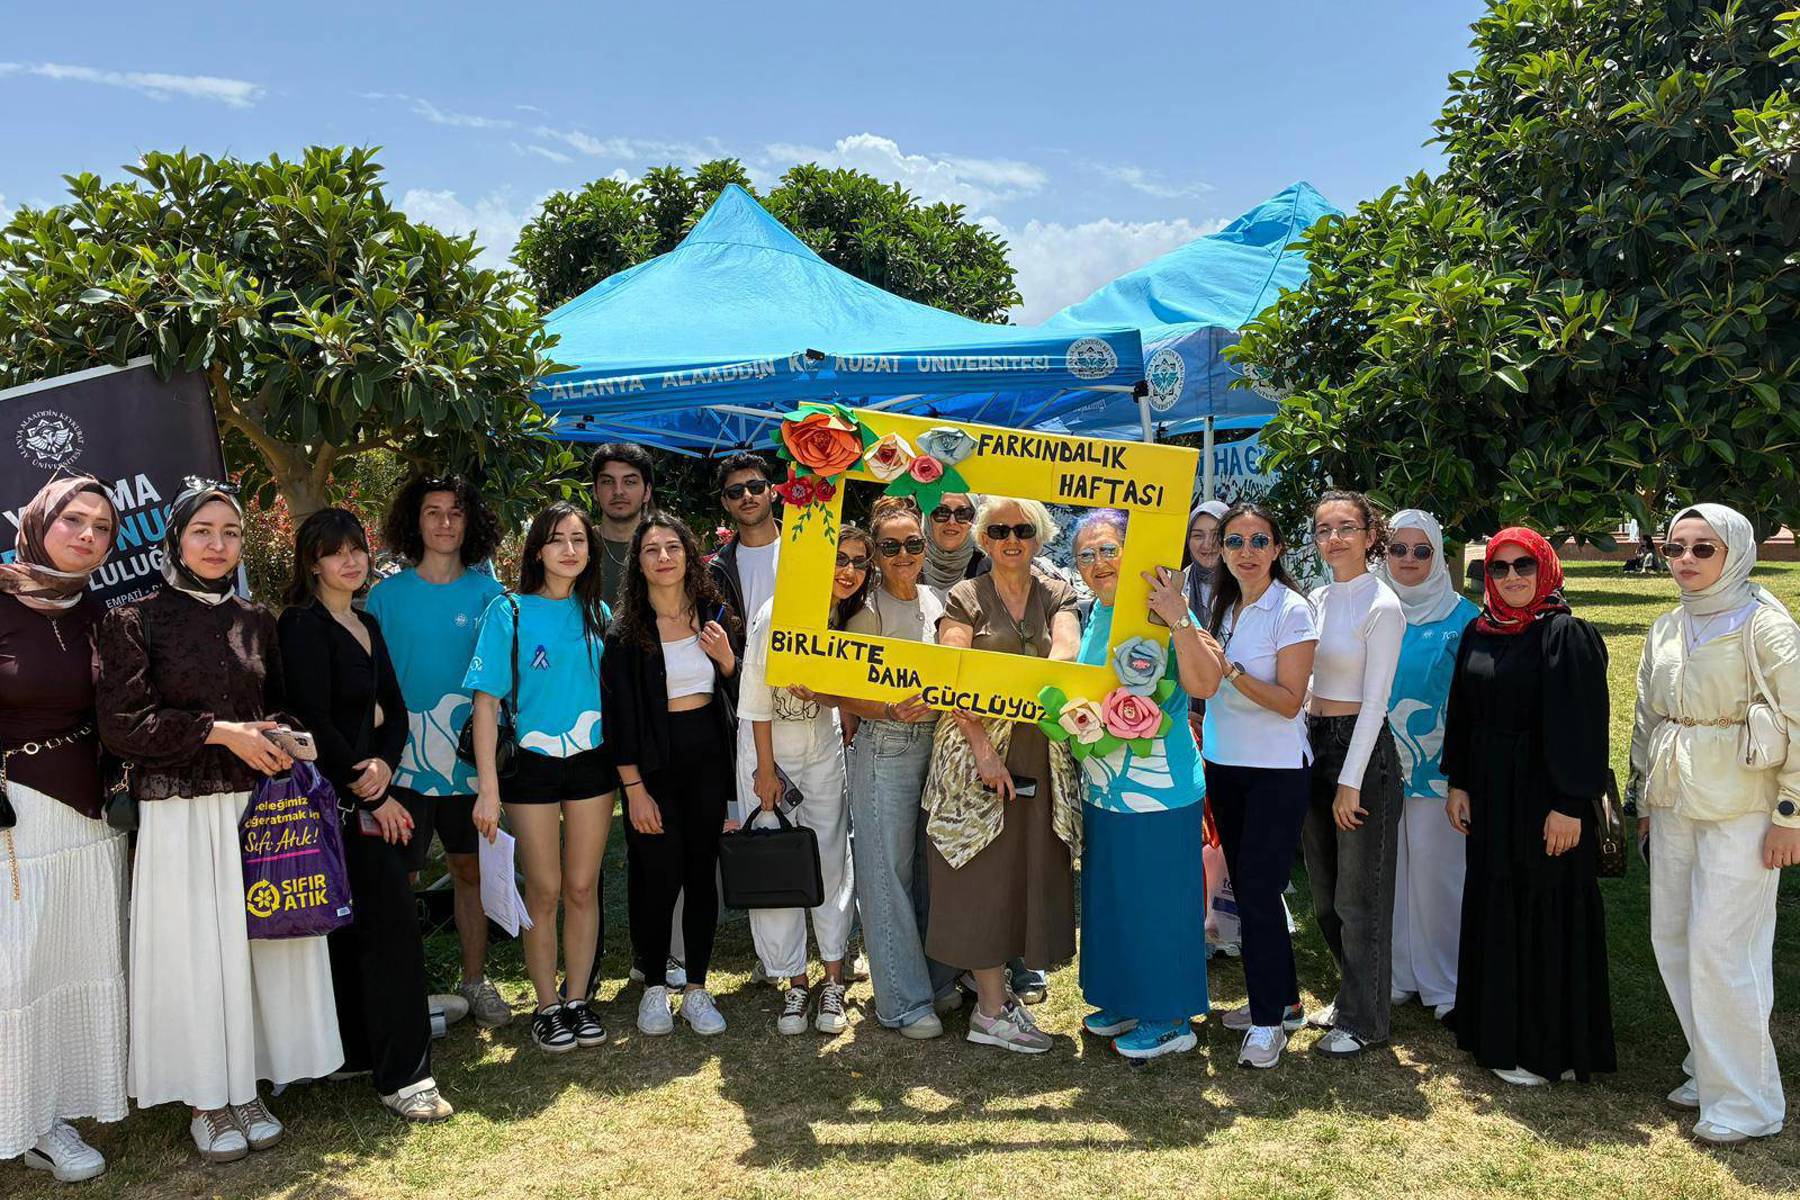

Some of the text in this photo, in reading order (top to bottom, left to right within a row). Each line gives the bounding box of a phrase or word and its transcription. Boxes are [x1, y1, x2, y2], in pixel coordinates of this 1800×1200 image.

[977, 433, 1127, 470] FARKINDALIK
[1059, 474, 1164, 507] HAFTASI
[105, 588, 143, 609] EMPATİ
[867, 664, 922, 688] DAHA
[281, 874, 326, 895] SIFIR
[284, 889, 329, 912] ATIK
